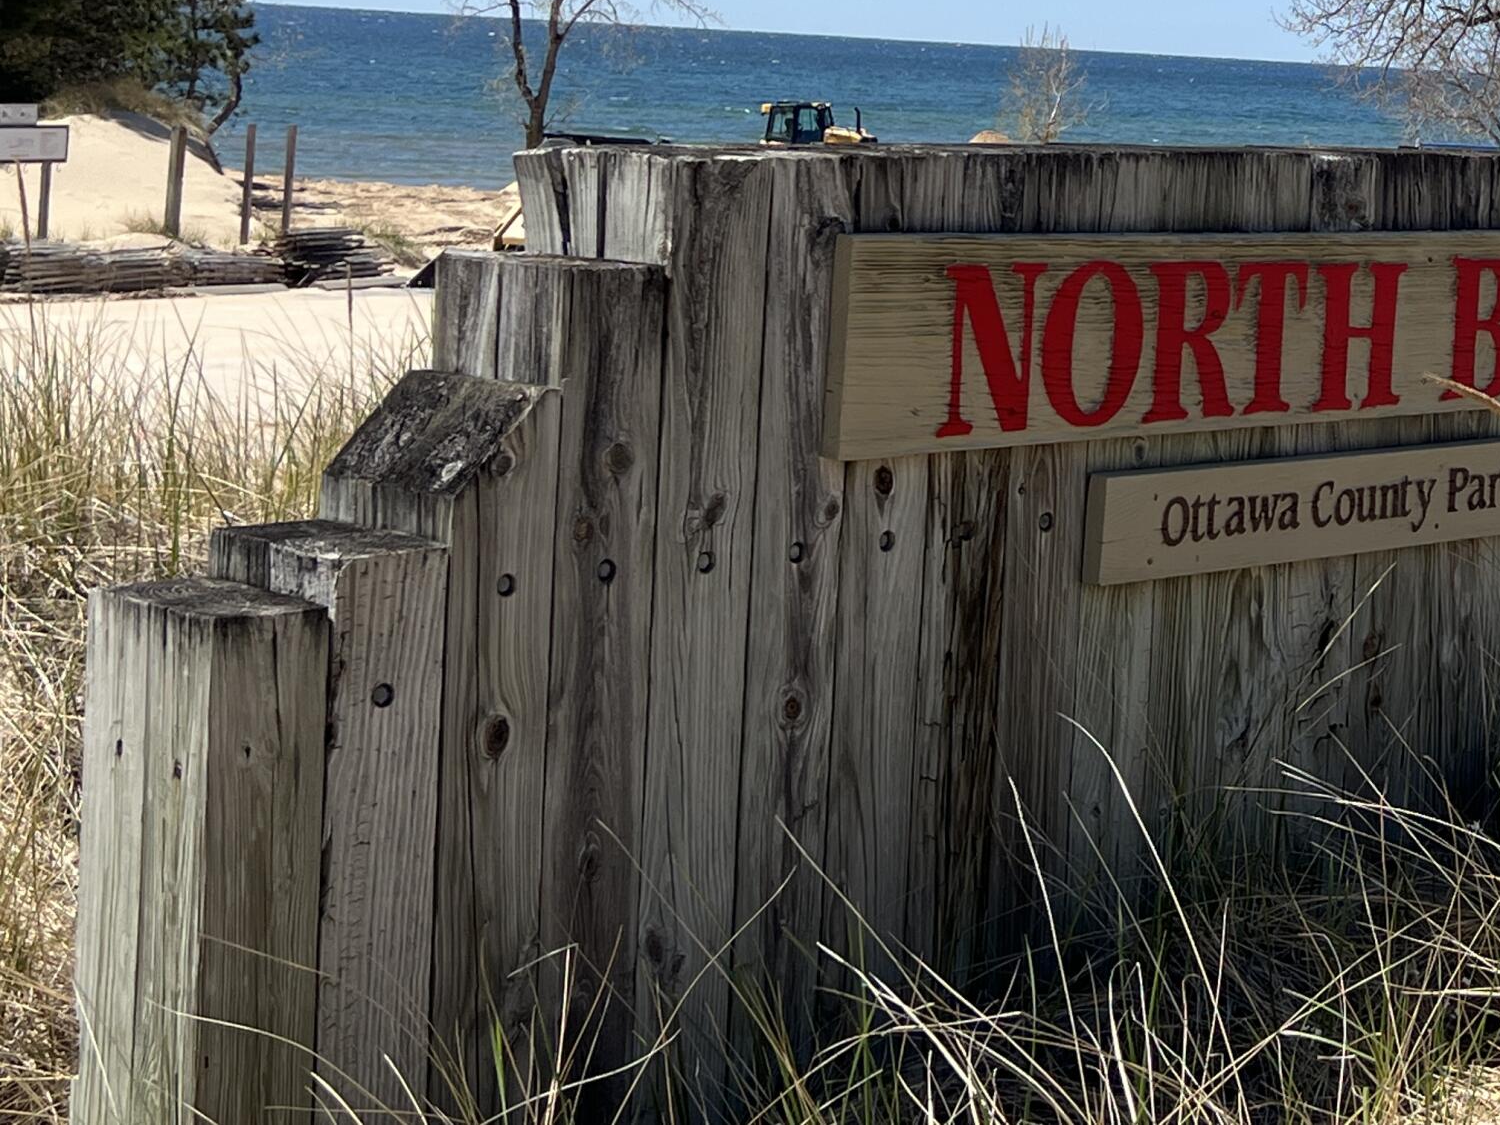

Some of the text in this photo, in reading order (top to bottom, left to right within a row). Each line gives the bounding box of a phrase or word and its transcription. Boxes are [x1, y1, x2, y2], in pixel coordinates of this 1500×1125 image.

[935, 260, 1407, 437] NORTH
[1160, 491, 1300, 547] Ottawa
[1310, 474, 1438, 531] County
